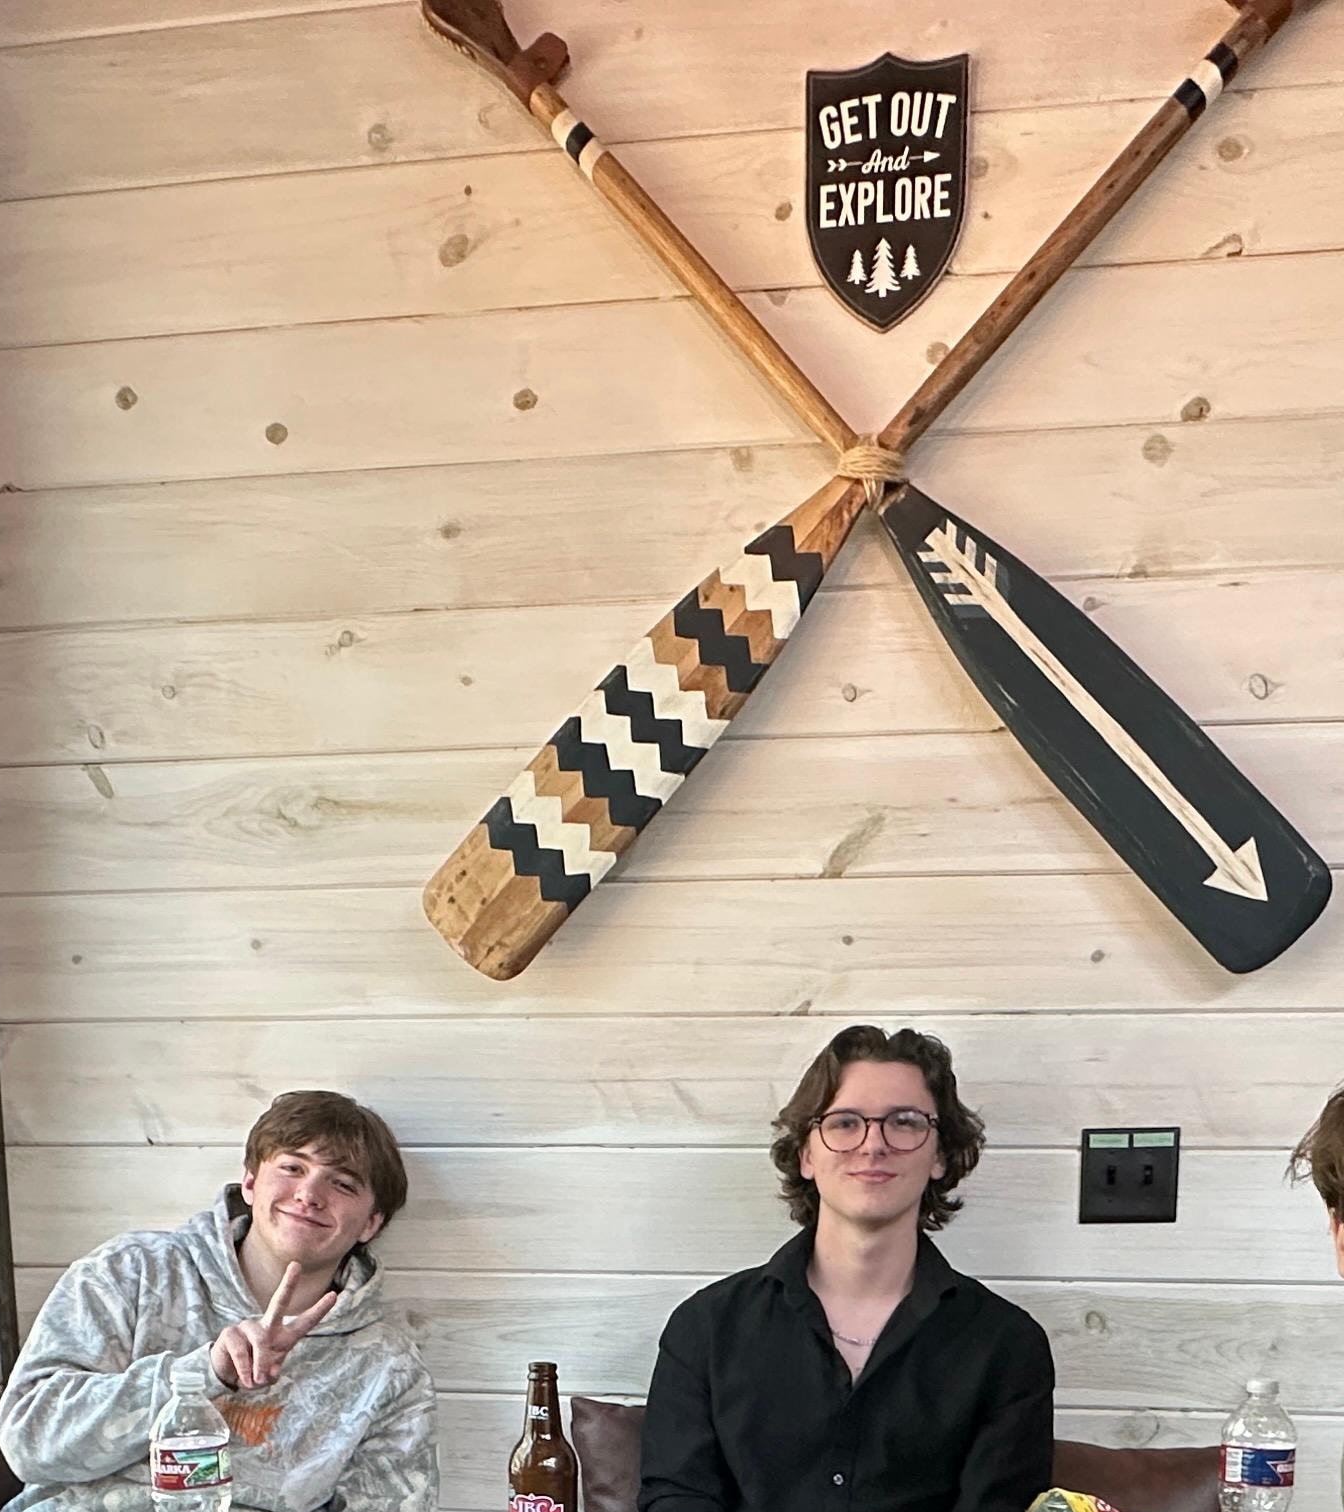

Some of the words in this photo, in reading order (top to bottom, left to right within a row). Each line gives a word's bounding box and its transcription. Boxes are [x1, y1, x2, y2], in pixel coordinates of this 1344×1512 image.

[818, 93, 883, 150] GET
[890, 91, 957, 139] OUT
[861, 146, 910, 173] And
[819, 173, 952, 229] EXPLORE
[528, 1404, 549, 1416] IBC
